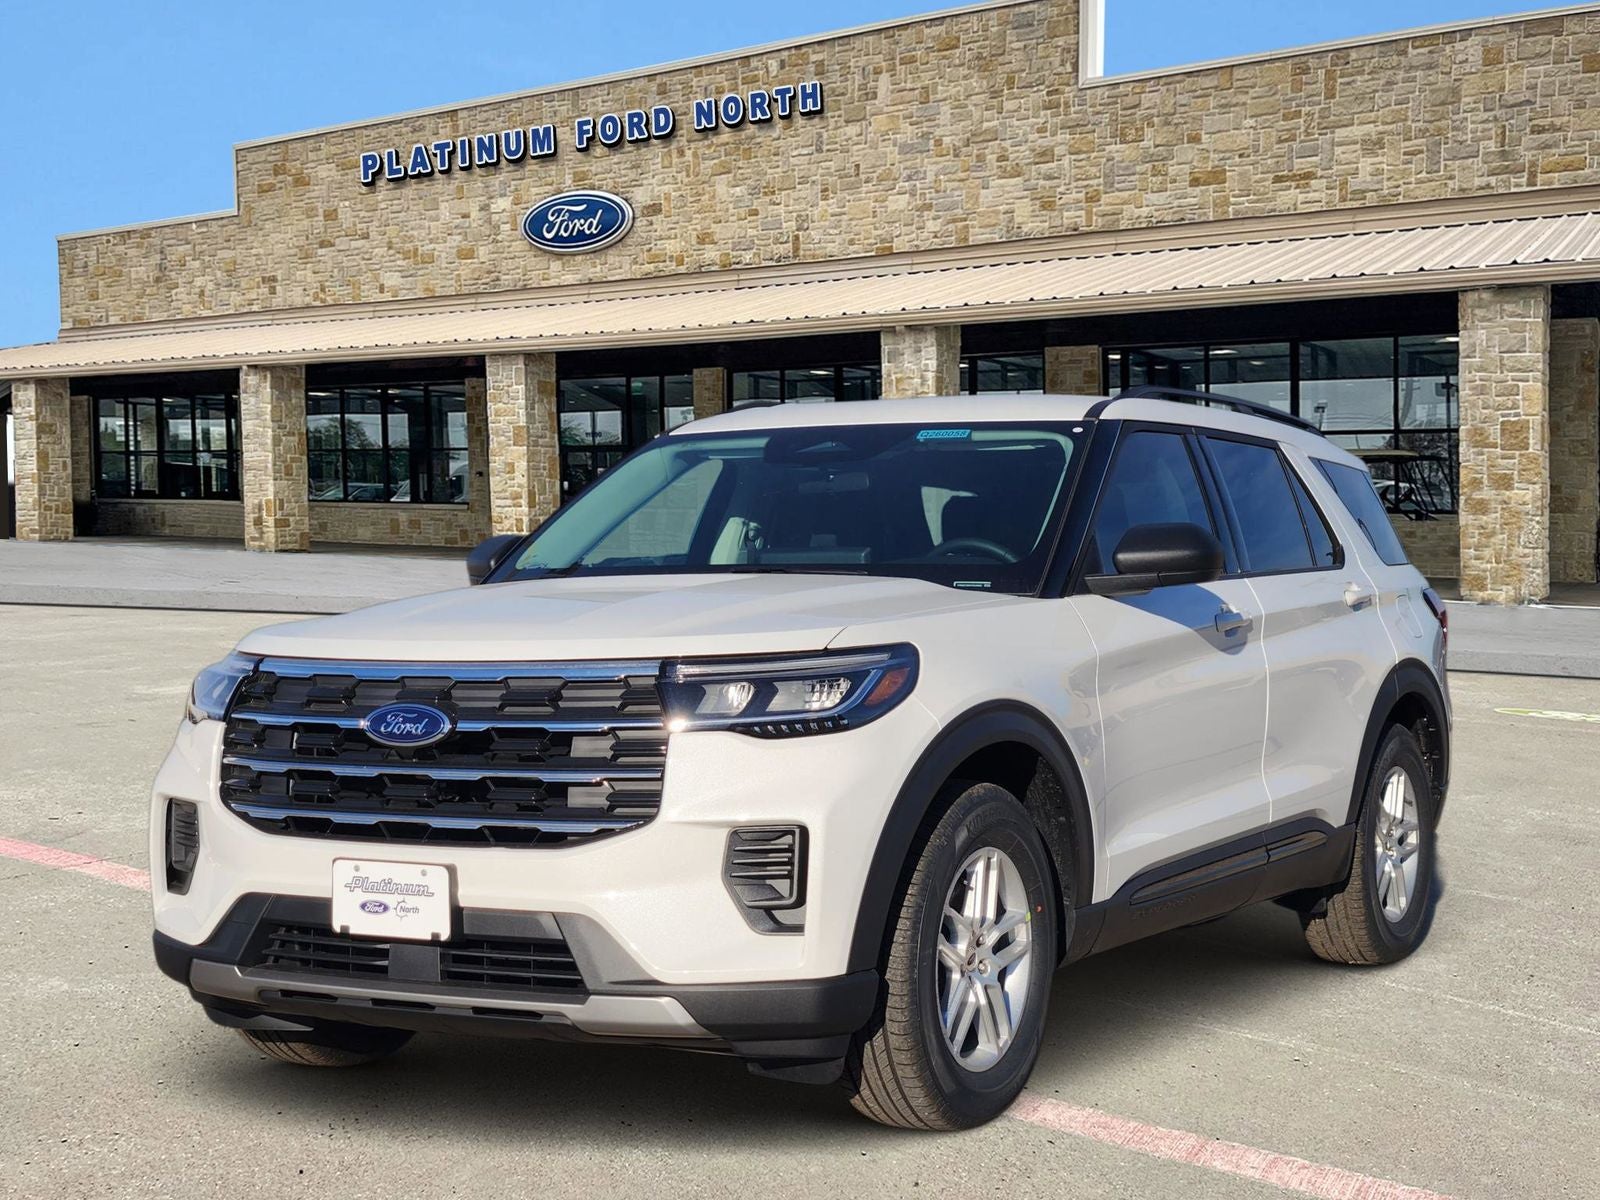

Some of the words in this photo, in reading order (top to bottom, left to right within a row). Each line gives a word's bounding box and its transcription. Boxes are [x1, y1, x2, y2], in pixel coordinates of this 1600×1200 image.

[361, 124, 556, 184] PLATINUM
[575, 105, 674, 149] FORD
[693, 81, 822, 130] NORTH
[542, 204, 603, 239] Ford
[380, 711, 429, 735] Ford
[344, 876, 435, 897] Platinum
[364, 902, 385, 914] Ford
[399, 904, 420, 914] North
